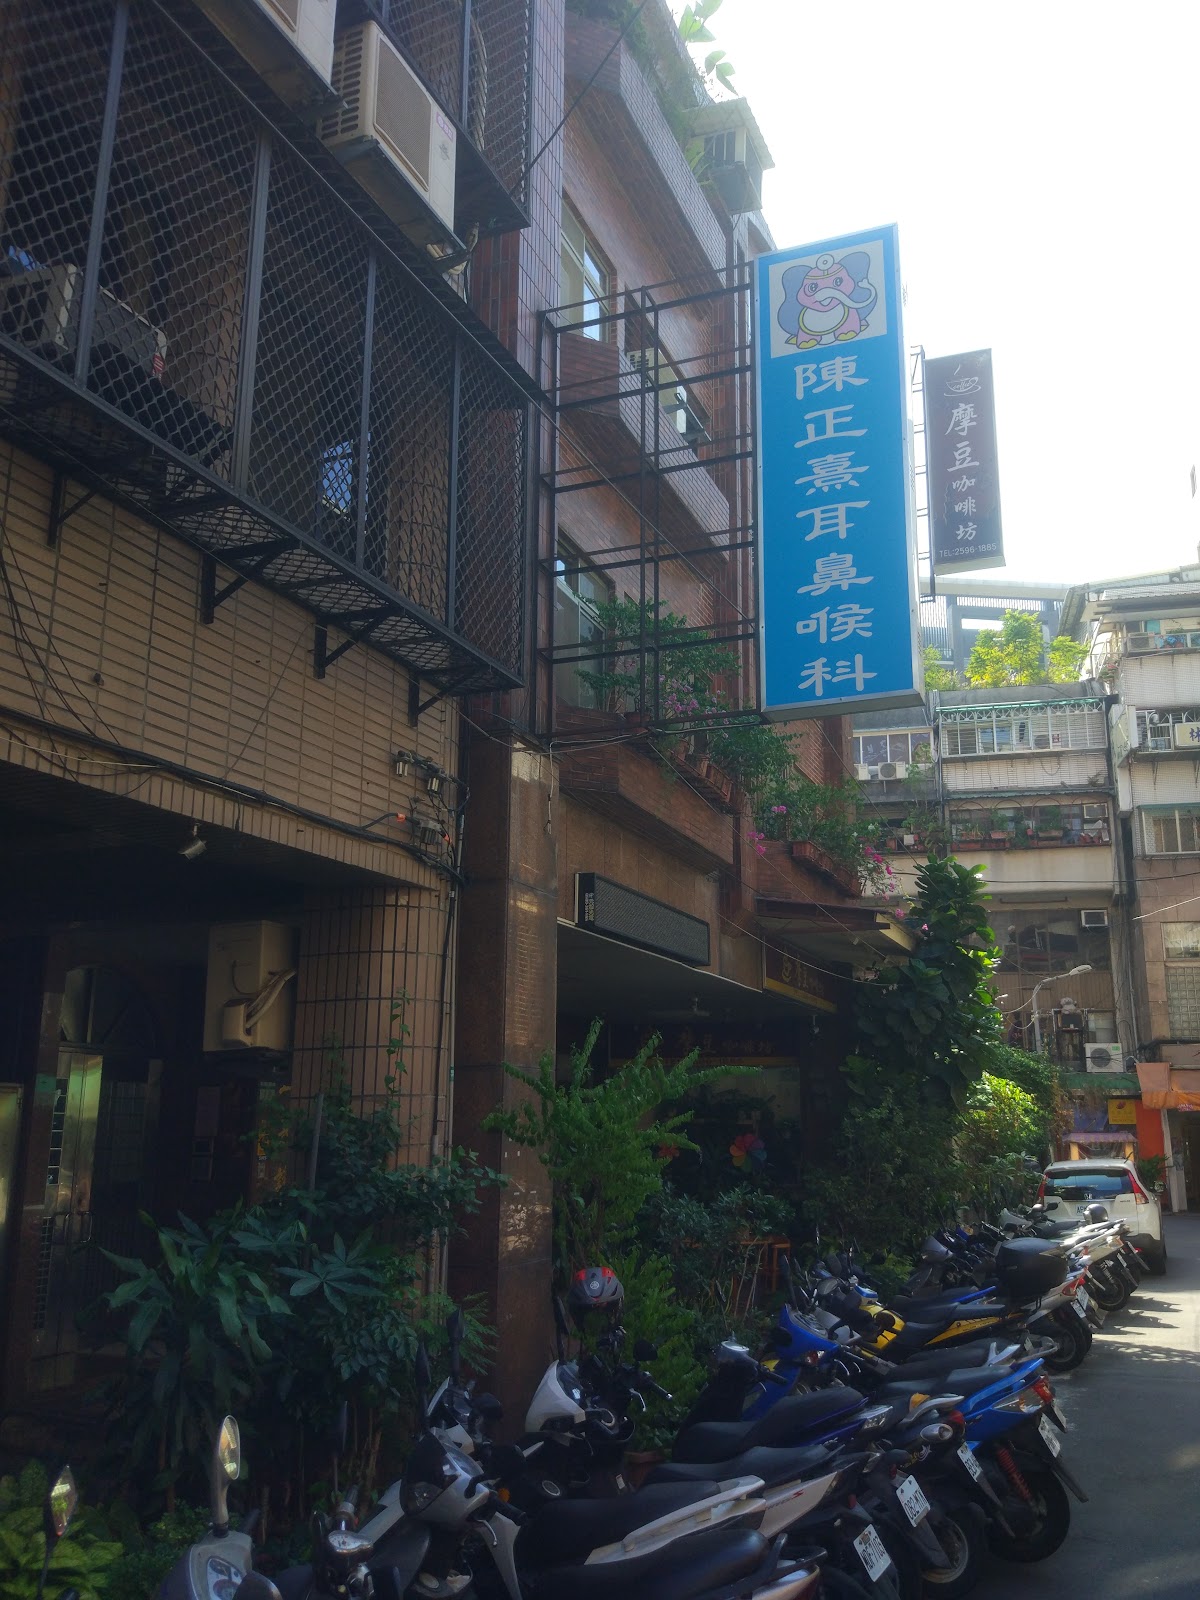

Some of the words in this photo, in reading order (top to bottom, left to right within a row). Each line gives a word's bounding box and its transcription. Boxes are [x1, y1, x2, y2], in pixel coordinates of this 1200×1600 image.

[794, 355, 877, 697] 陳正熹耳鼻喉科
[944, 402, 980, 541] 摩豆咖啡坊
